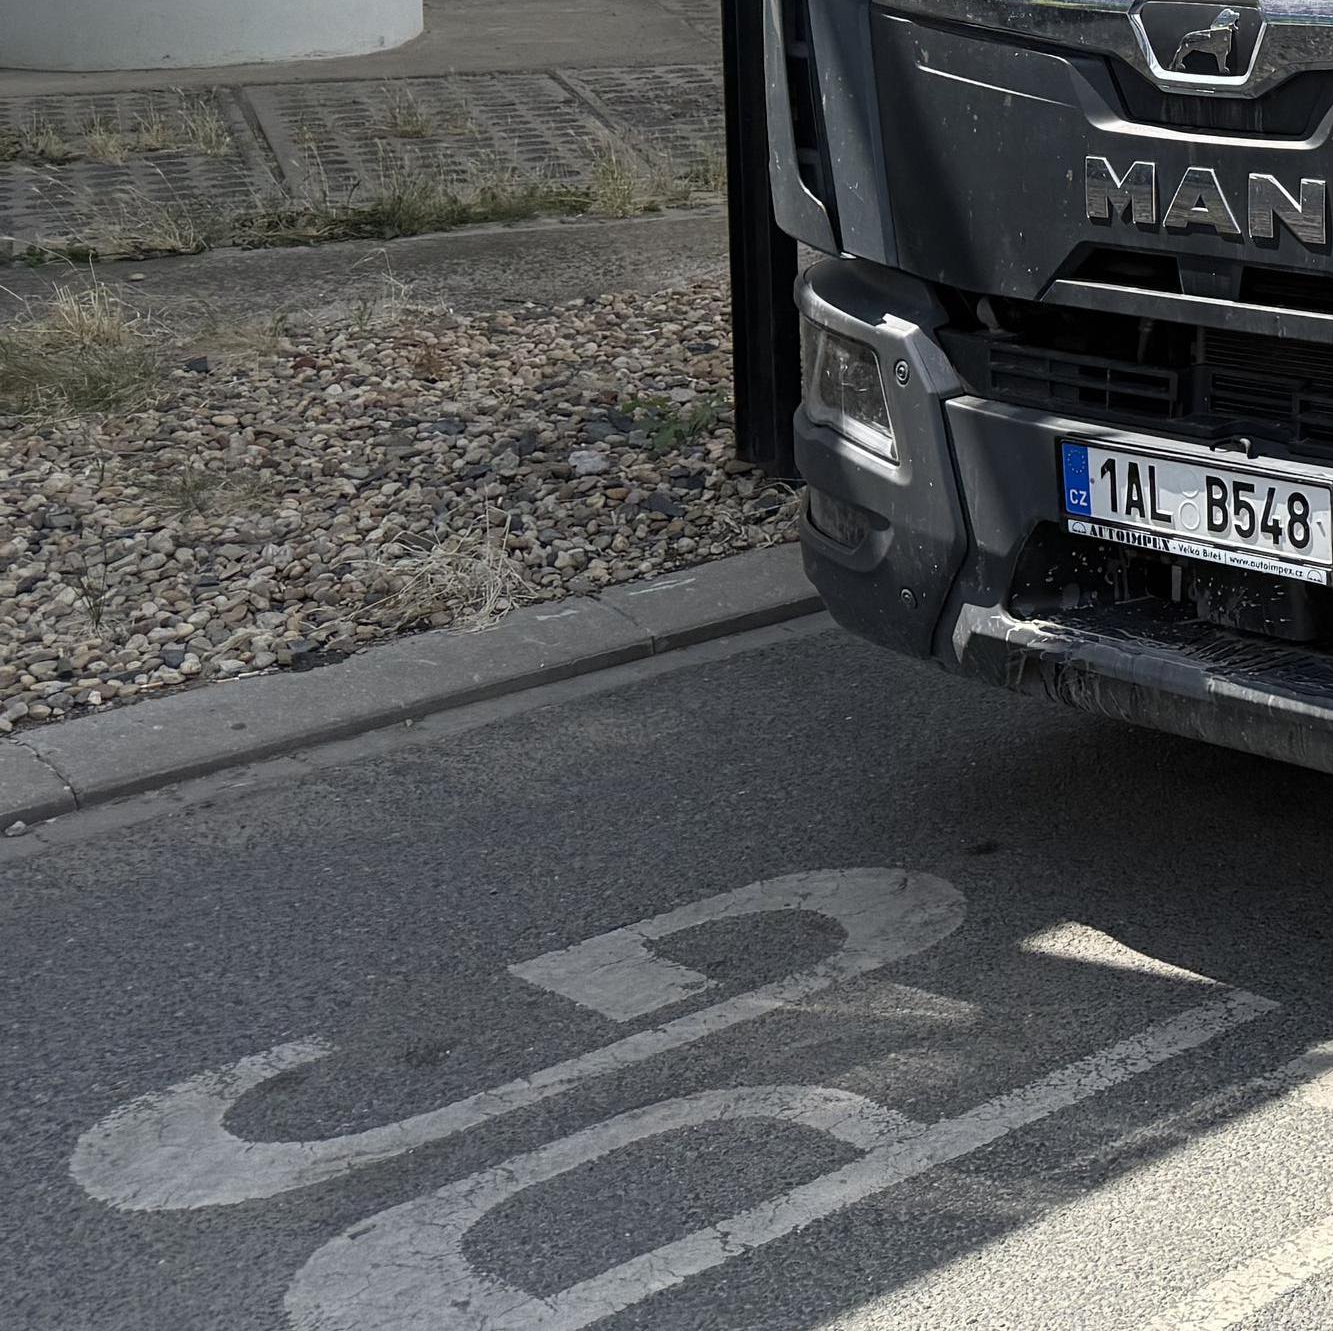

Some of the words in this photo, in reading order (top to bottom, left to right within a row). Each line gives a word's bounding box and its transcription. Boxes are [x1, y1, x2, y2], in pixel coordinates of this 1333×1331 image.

[1085, 155, 1328, 246] MAN
[1069, 488, 1088, 507] CZ
[1100, 457, 1172, 524] 1AL
[1205, 474, 1311, 550] B548
